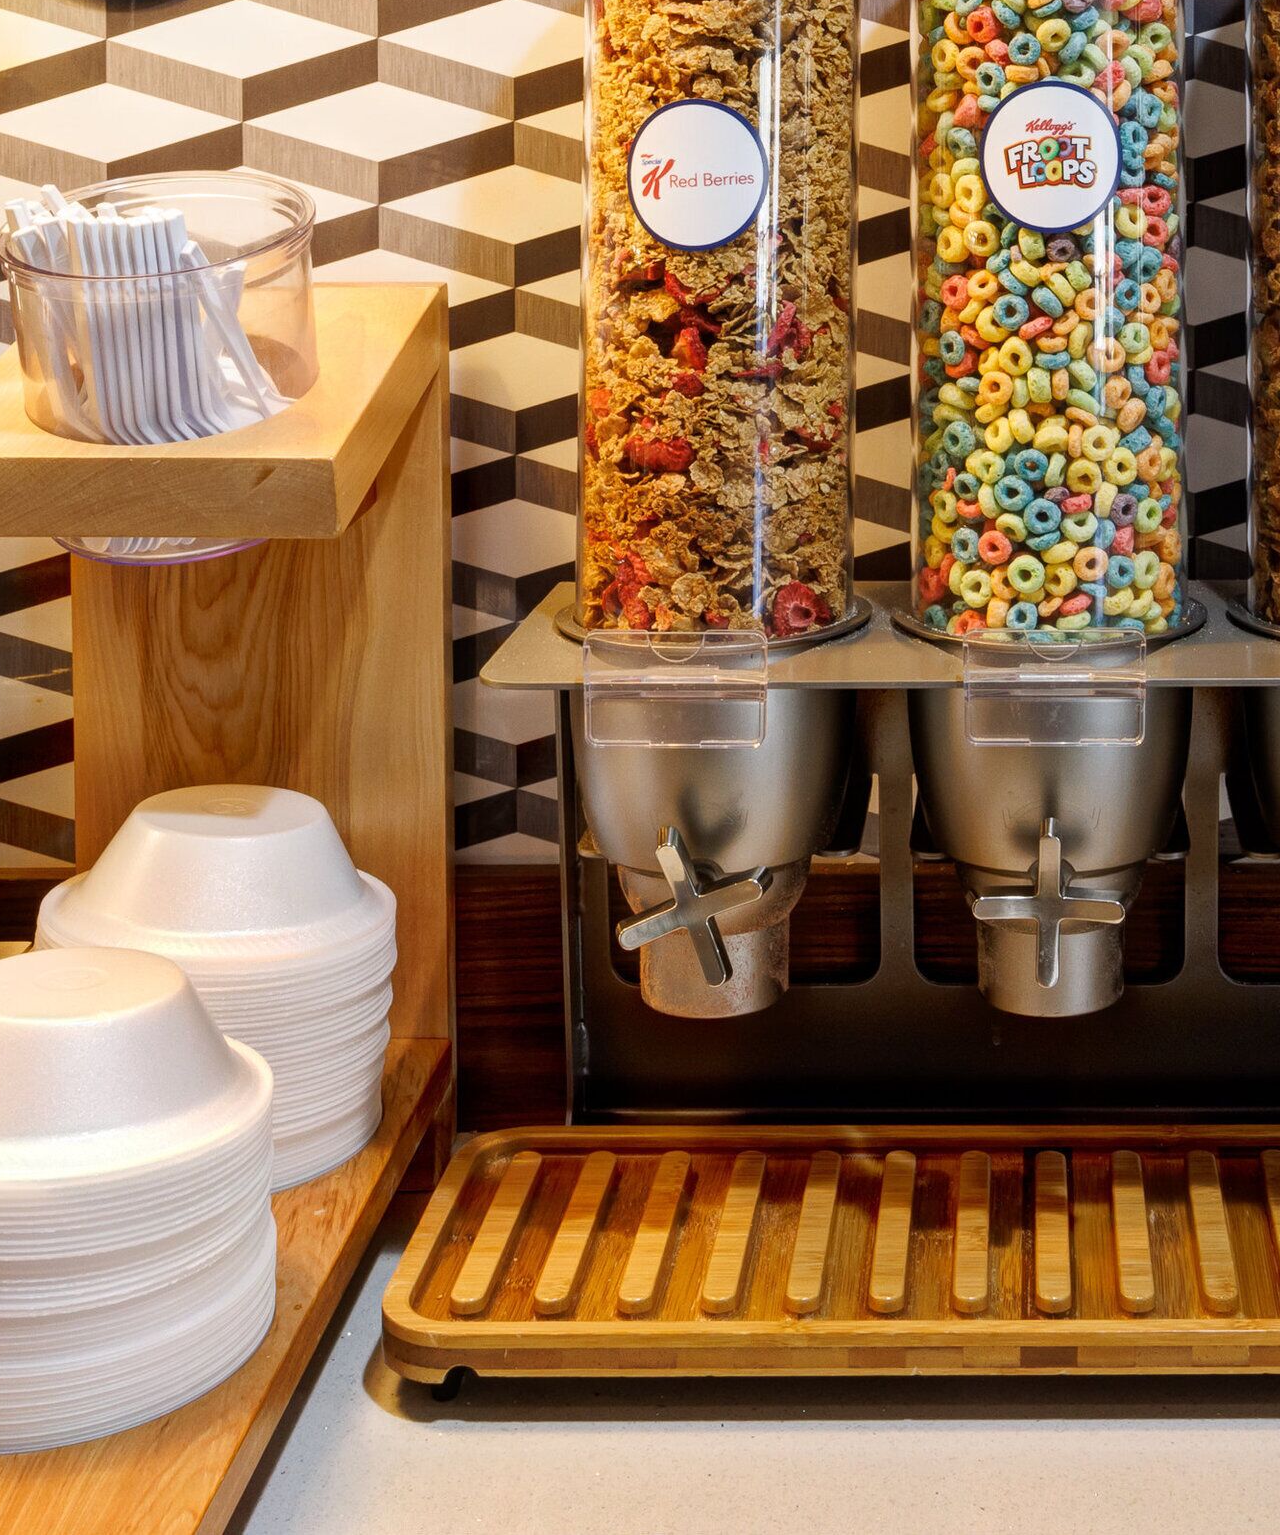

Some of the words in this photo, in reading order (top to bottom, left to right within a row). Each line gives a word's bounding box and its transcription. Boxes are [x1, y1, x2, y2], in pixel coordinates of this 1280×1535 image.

[1025, 118, 1076, 136] Kellogg's
[1008, 137, 1089, 169] FROOT
[642, 159, 675, 199] K
[670, 172, 698, 188] Red
[703, 172, 755, 187] Berries
[1022, 160, 1095, 185] LOOPS
